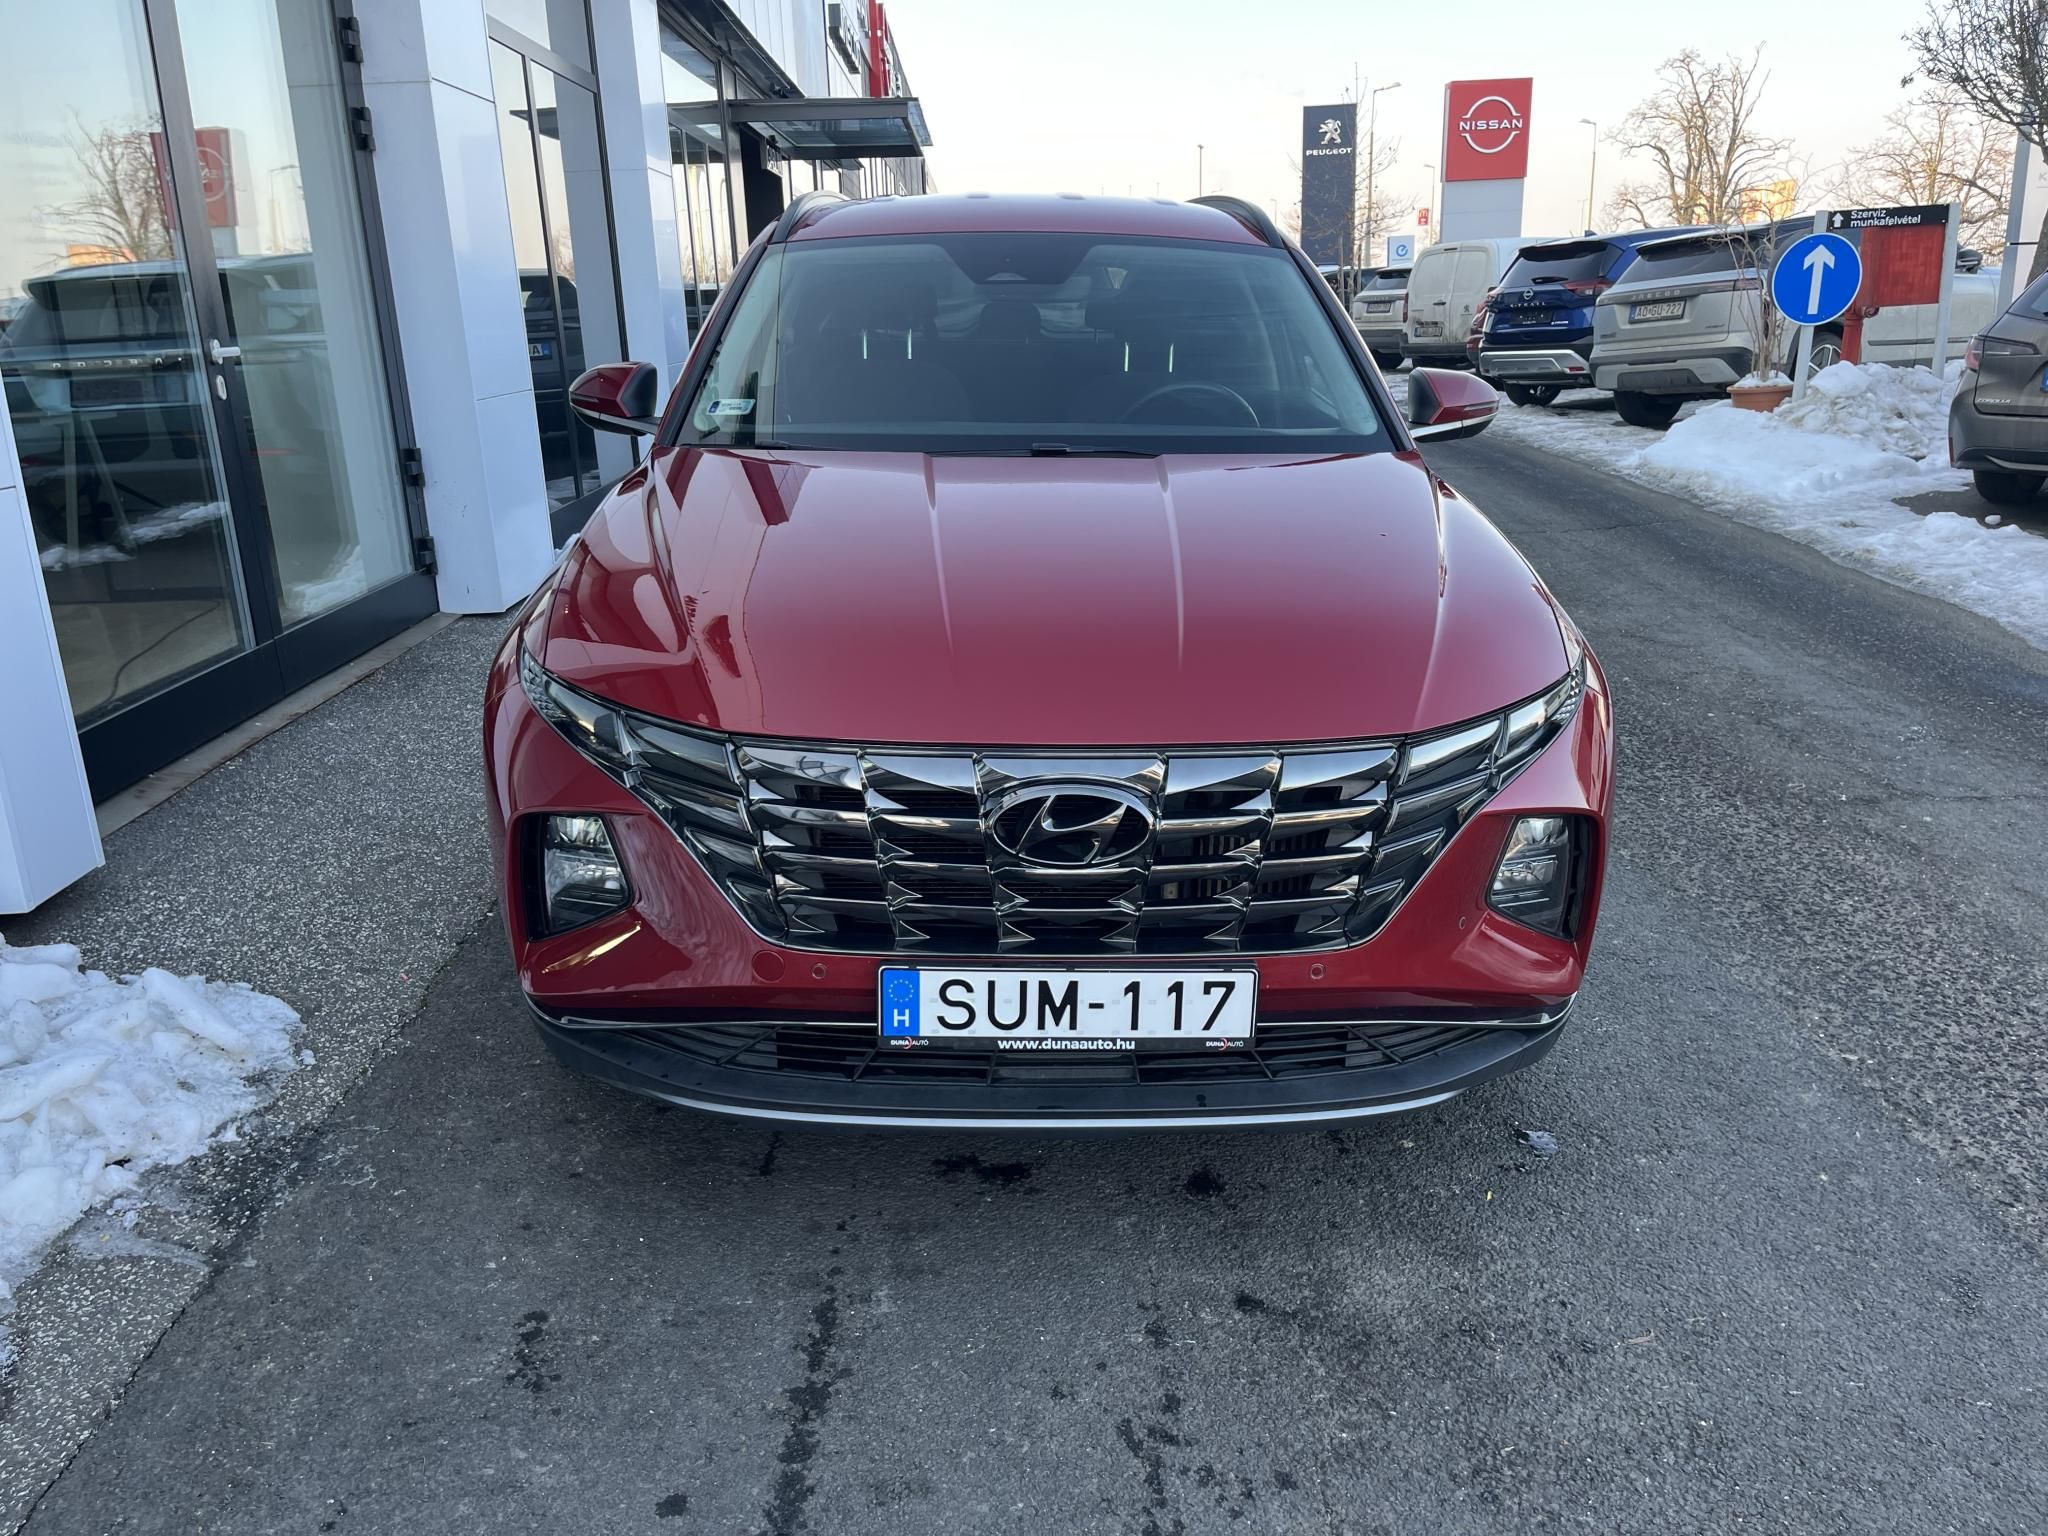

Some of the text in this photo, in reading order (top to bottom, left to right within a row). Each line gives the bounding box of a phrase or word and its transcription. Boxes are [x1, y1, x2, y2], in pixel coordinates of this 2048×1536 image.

[1459, 118, 1523, 131] NISSAN
[1305, 147, 1353, 156] PEUGEOT
[1850, 210, 1887, 219] Szerviz
[1850, 215, 1921, 228] munkafelvétel
[893, 978, 1236, 1031] H SUM-117
[997, 1038, 1136, 1050] www.dunaauto.hu
